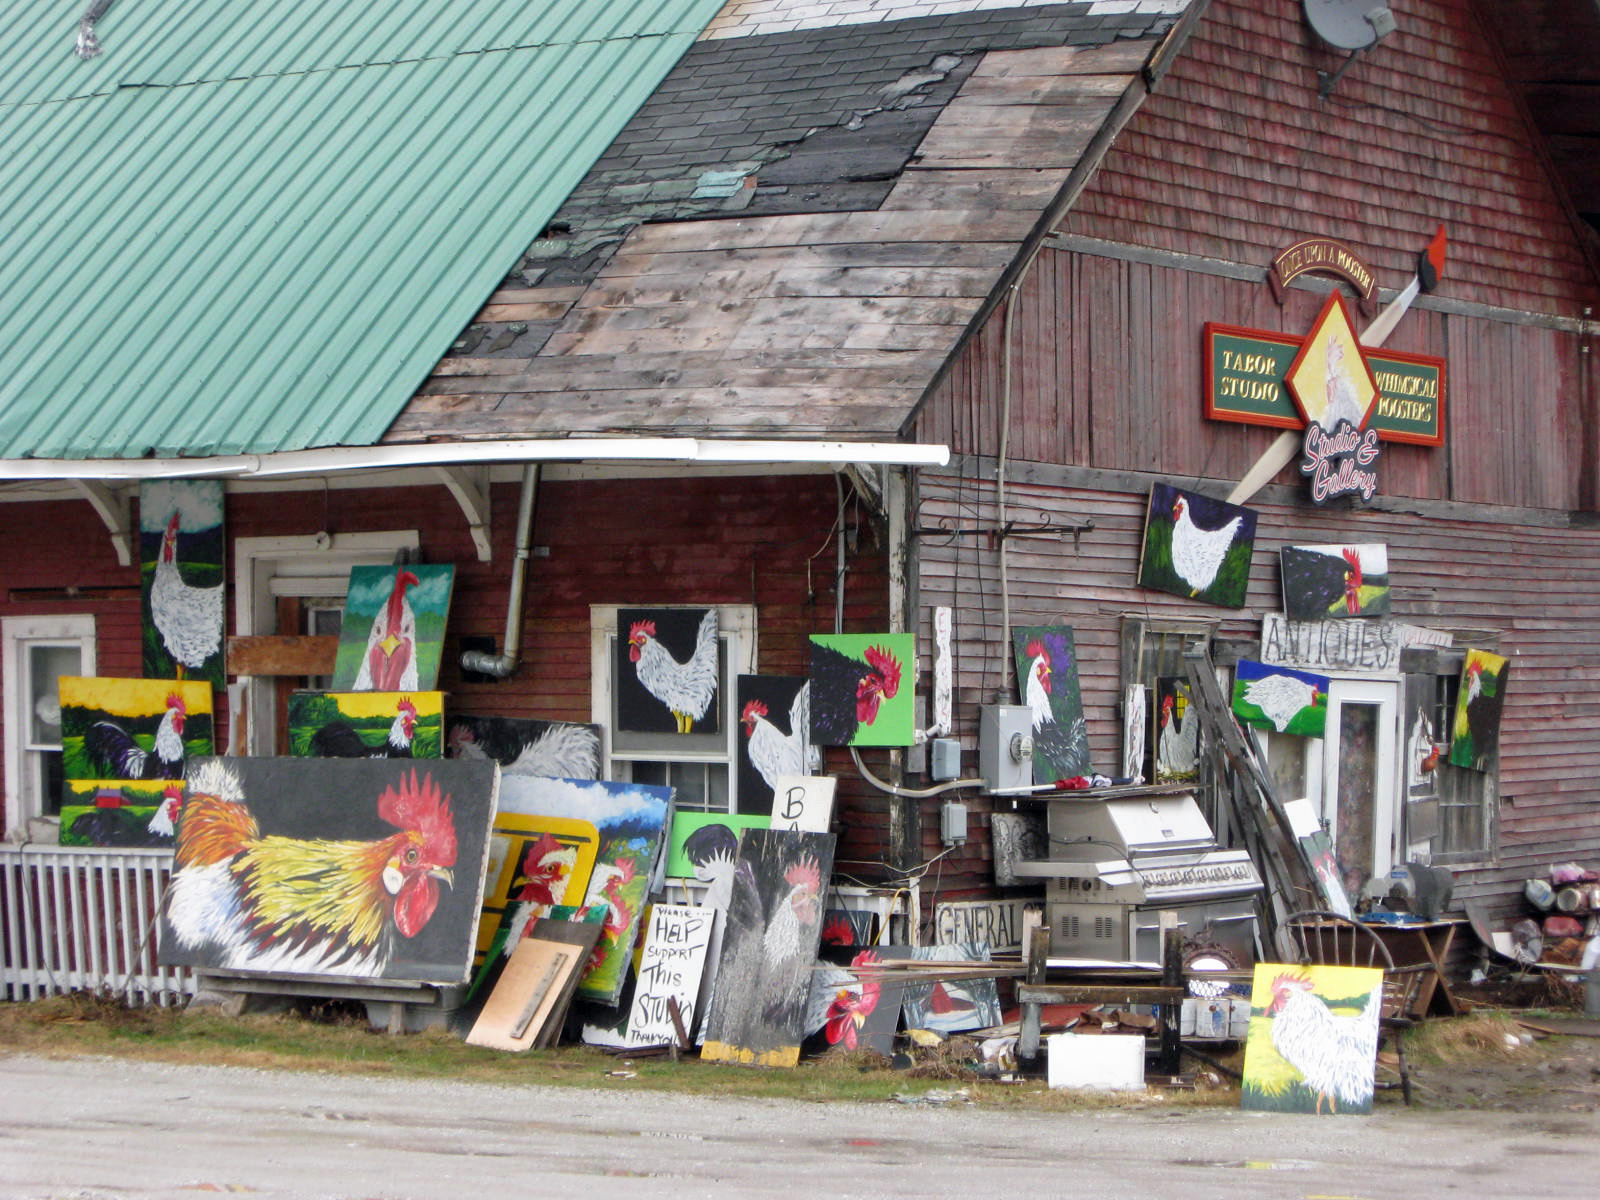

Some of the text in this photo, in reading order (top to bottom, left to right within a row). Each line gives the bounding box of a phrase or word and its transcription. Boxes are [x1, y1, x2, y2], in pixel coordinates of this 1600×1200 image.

[1328, 247, 1336, 264] A
[1223, 350, 1276, 377] TABOR
[1220, 376, 1279, 403] STUDIO
[1375, 371, 1437, 399] WHIMSICAL
[1377, 397, 1432, 423] ROOSTERS
[1302, 423, 1379, 472] Studio &
[1314, 458, 1376, 501] Gallery
[1264, 617, 1394, 671] ANTIQUES
[781, 786, 806, 820] B
[655, 916, 704, 943] HELP
[939, 903, 1022, 949] GENERAL
